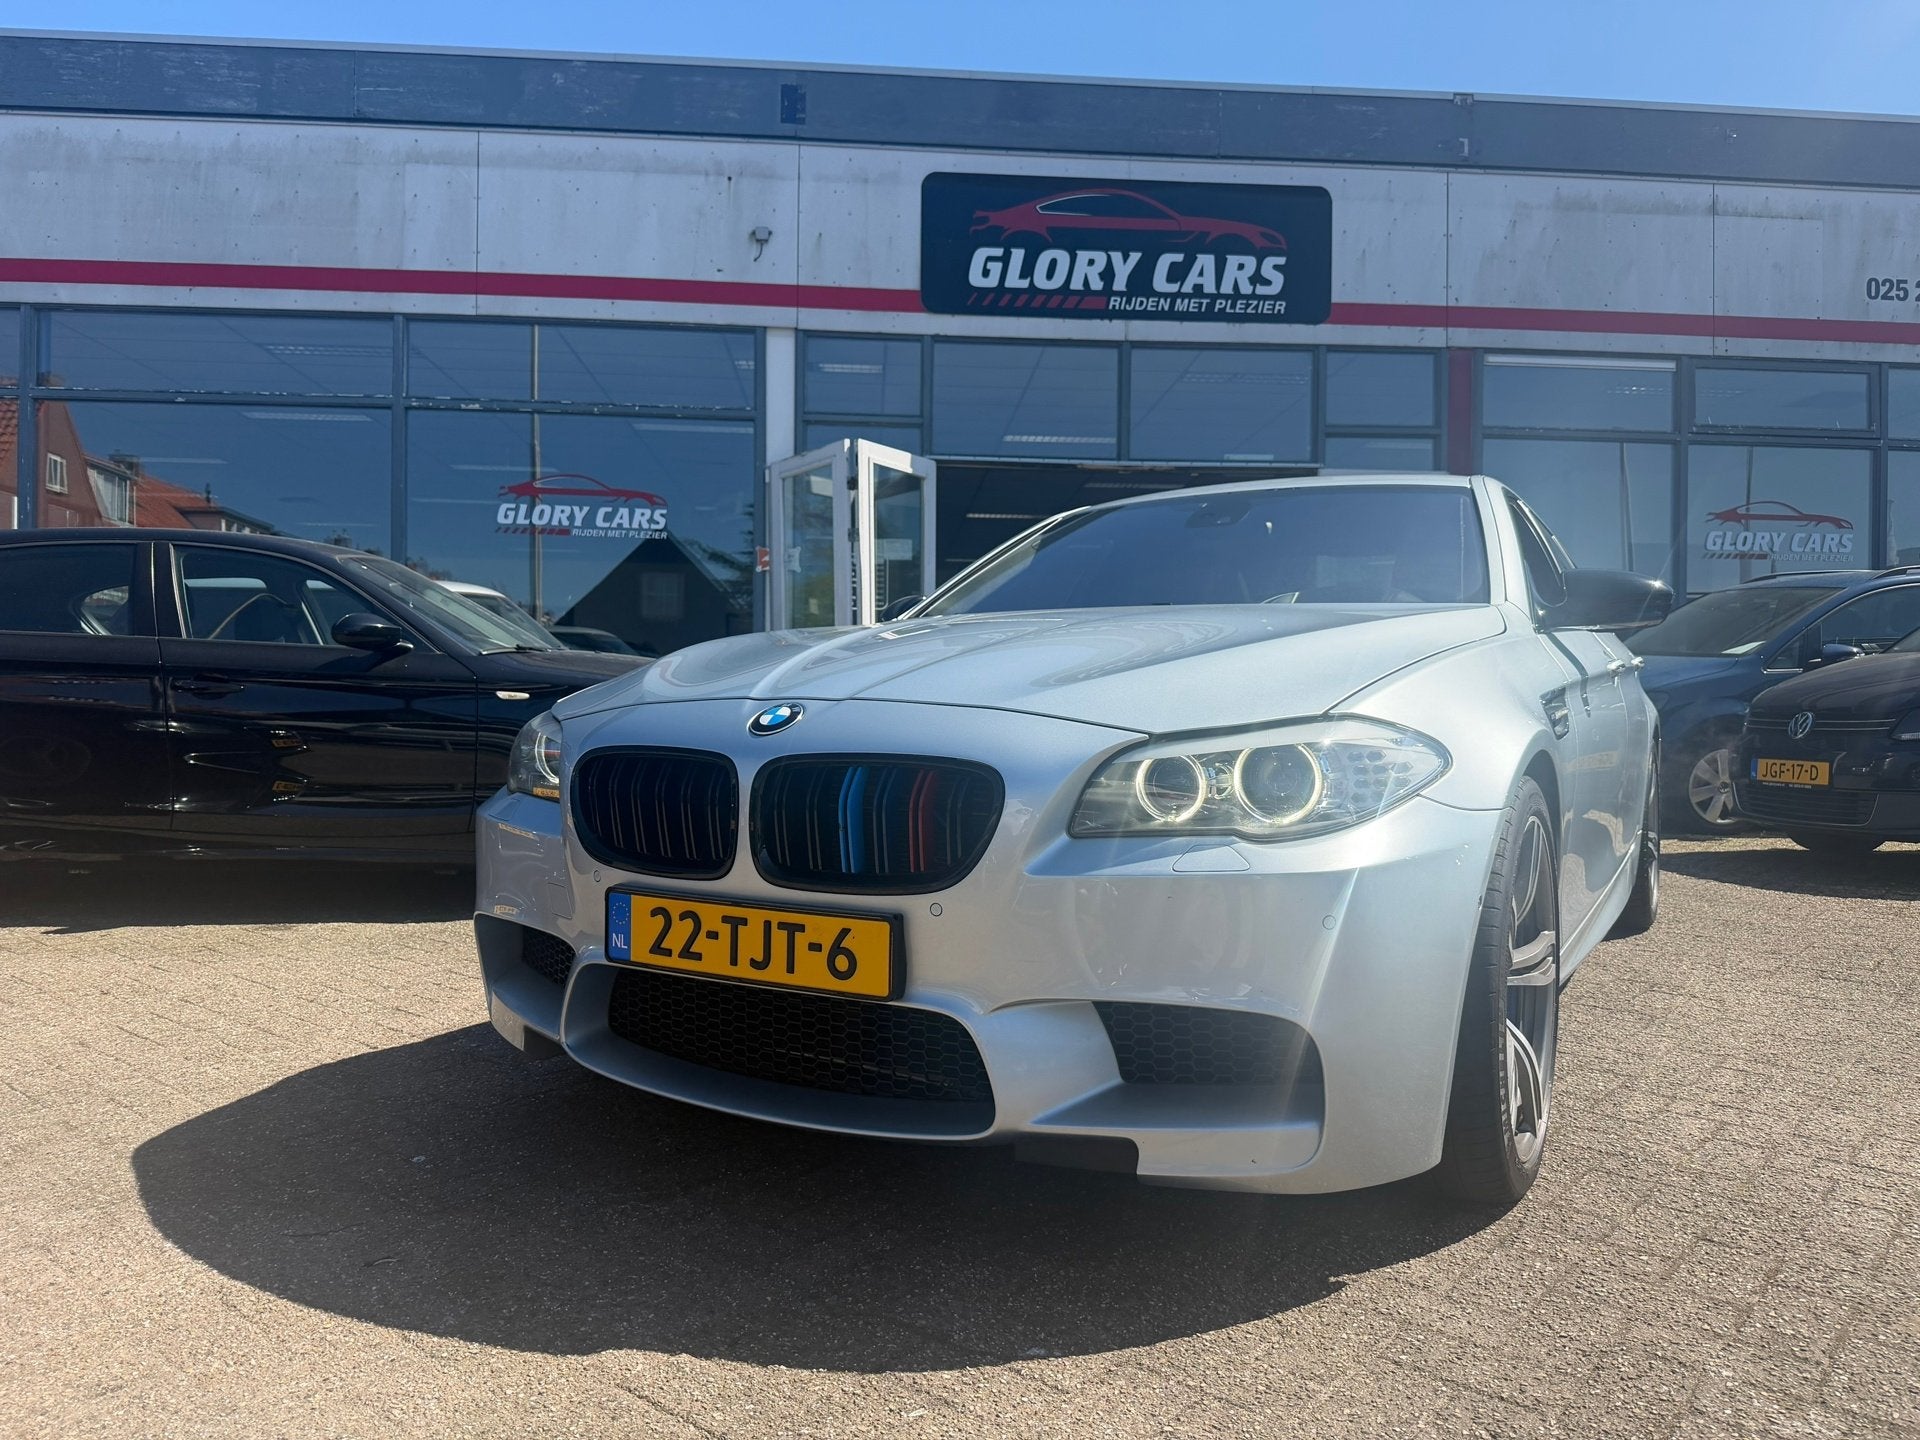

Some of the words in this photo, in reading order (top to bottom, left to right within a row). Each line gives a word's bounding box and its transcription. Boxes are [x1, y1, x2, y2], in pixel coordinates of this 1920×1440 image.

[968, 246, 1142, 292] GLORY
[1151, 252, 1288, 296] CARS
[1866, 277, 1909, 302] 025
[1108, 295, 1169, 312] RIJDEN
[1174, 297, 1210, 312] MET
[1213, 298, 1287, 315] PLEZIER
[497, 503, 590, 527] GLORY
[596, 507, 667, 530] CARS
[572, 528, 606, 538] RIJDEN
[607, 529, 627, 539] MET
[628, 530, 668, 540] PLEZIER
[1706, 531, 1786, 551] GLORY
[1791, 533, 1854, 552] CARS
[1762, 762, 1819, 781] JGF-17-D
[612, 933, 628, 949] NL
[649, 906, 858, 981] 22-TJT-6
